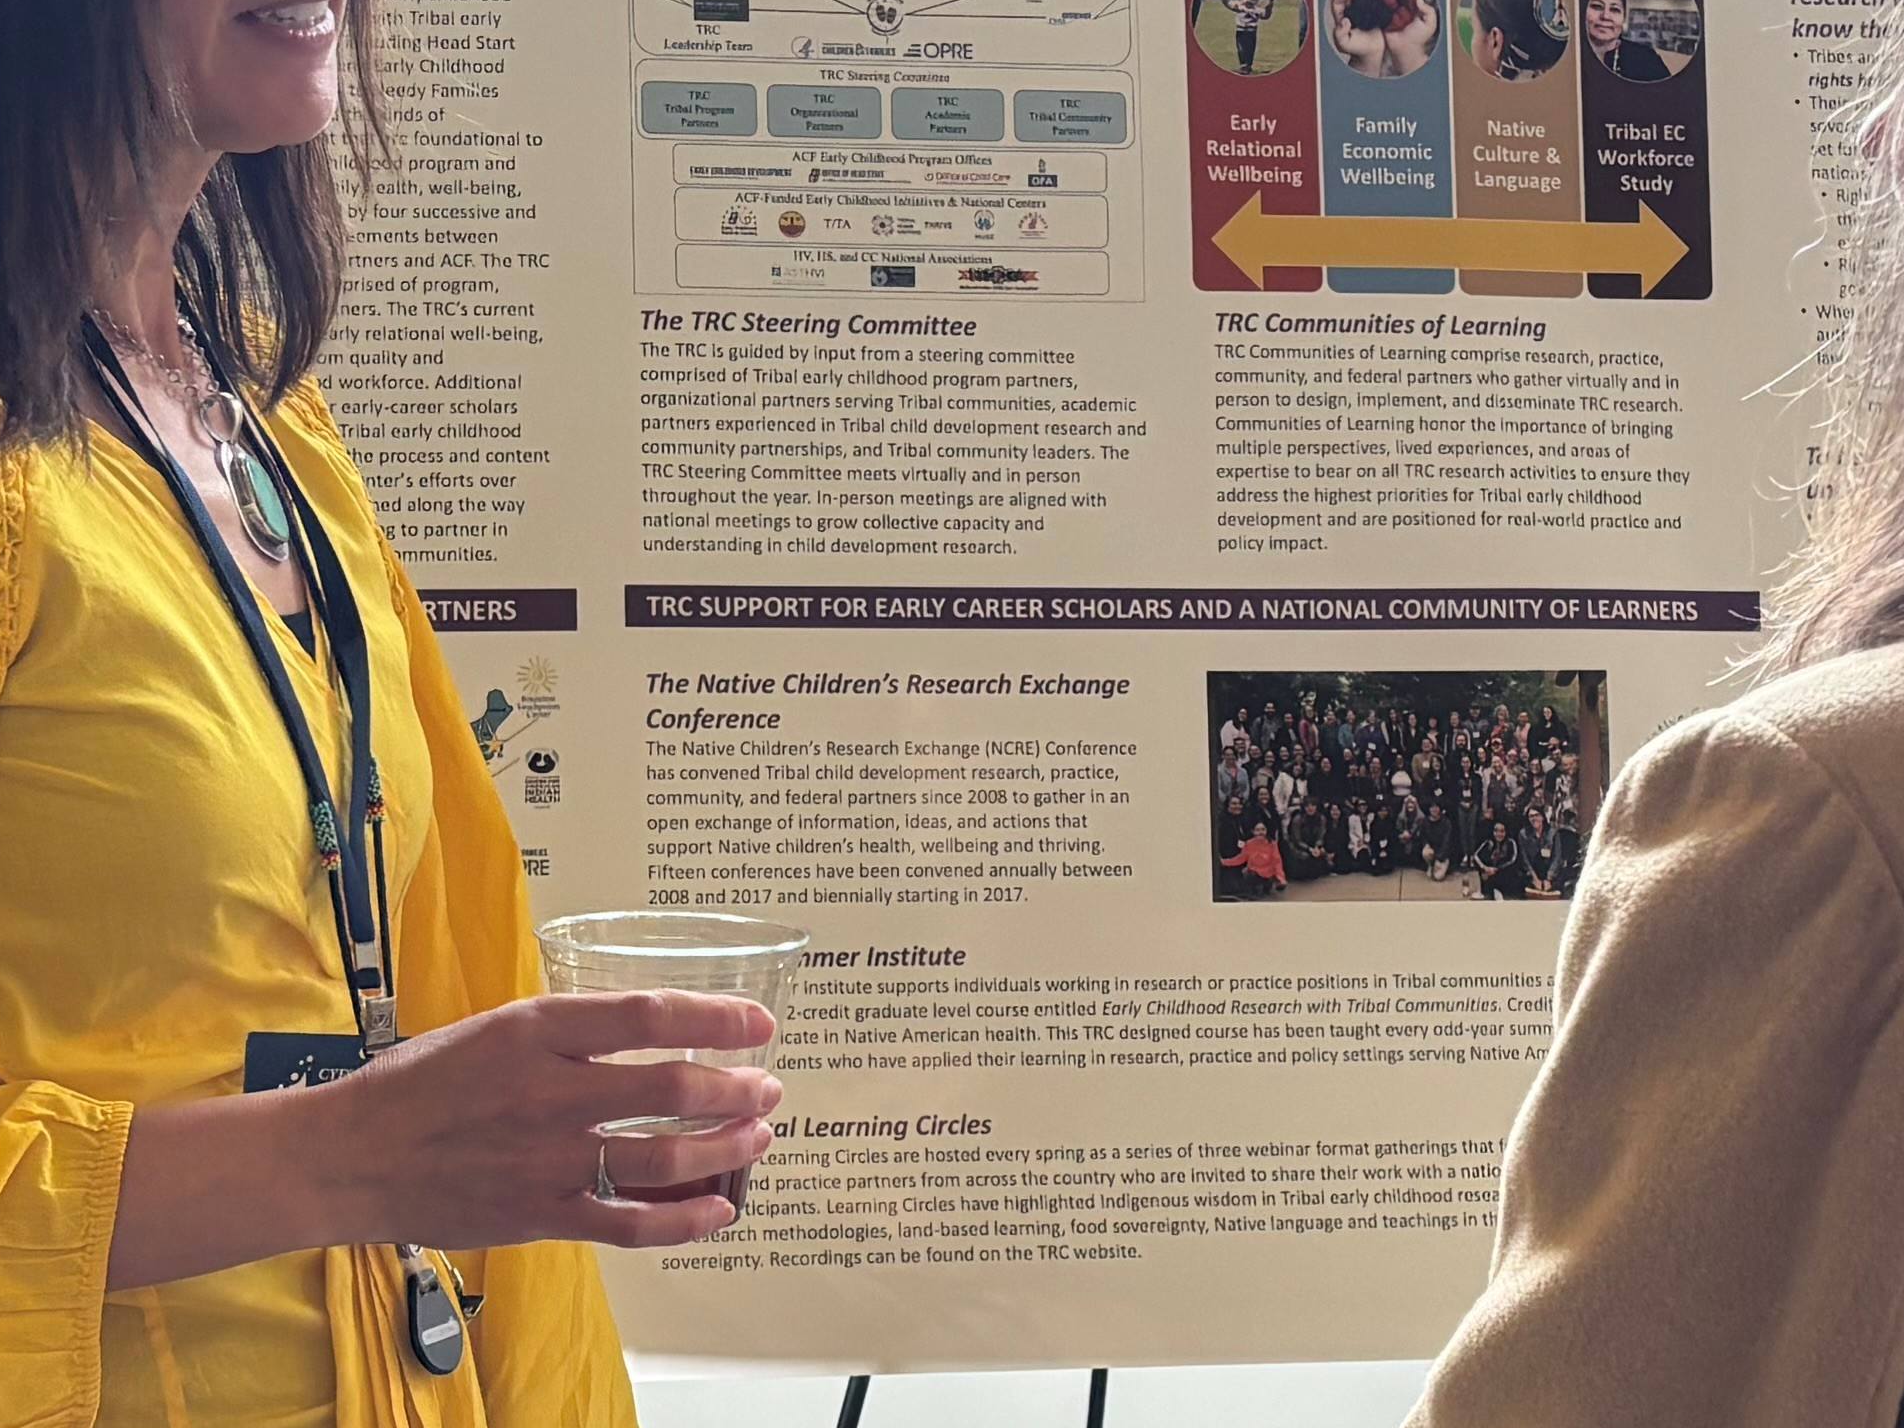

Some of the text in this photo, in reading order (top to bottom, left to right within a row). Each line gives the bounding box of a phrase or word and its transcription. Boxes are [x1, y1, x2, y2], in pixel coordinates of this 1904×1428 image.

[1792, 18, 1854, 38] know
[428, 34, 515, 51] Head Start
[923, 42, 974, 60] OPRE
[1807, 49, 1854, 64] Tribes
[1808, 72, 1854, 90] rights
[1231, 114, 1277, 135] Early
[1356, 117, 1417, 138] Family
[1488, 120, 1545, 138] Native
[1605, 123, 1685, 141] Tribal EC
[1207, 139, 1301, 158] Relational
[1343, 142, 1432, 160] Economic
[1473, 145, 1561, 165] Culture &
[1597, 148, 1694, 167] Workforce
[1207, 165, 1302, 187] Wellbeing
[1340, 167, 1435, 189] Wellbeing
[1475, 170, 1561, 193] Language
[1621, 174, 1673, 196] Study
[404, 253, 549, 269] and ACF. The TRC
[641, 309, 976, 338] The TRC Steering Committee
[1216, 312, 1546, 342] TRC Communities of Learning
[639, 341, 1075, 366] The TRC is guided by input from a steering committee
[1214, 344, 1663, 368] TRC Communities of Learning comprise research, practice,
[339, 373, 521, 389] workforce. Additional
[1218, 535, 1328, 553] policy impact.
[426, 601, 517, 621] RTNERS
[646, 595, 1698, 621] TRC SUPPORT FOR EARLY CAREER SCHOLARS AND A NATIONAL COMMUNITY OF LEARNERS
[646, 672, 1130, 699] The Native Children’s Research Exchange
[646, 708, 780, 733] Conference
[645, 739, 1136, 759] The Native Children’s Research Exchange (NCRE) Conference
[649, 886, 1028, 907] 2008 and 2017 and biennially starting in 2017.
[798, 945, 966, 968] mmer Institute
[785, 1004, 850, 1021] 2-credit
[855, 1003, 928, 1023] graduate
[933, 1001, 970, 1018] level
[976, 1005, 1029, 1018] course
[1034, 1000, 1096, 1018] entitled
[1103, 1000, 1142, 1019] Early
[1147, 999, 1226, 1016] Childhood
[1231, 999, 1302, 1015] Research
[1307, 997, 1341, 1013] with
[1347, 998, 1390, 1013] Tribal
[1395, 997, 1501, 1013] Communities.
[804, 1115, 908, 1141] Learning
[916, 1113, 992, 1136] Circles
[662, 1244, 1142, 1272] sovereignty. Recordings can be found on the TRC website.
